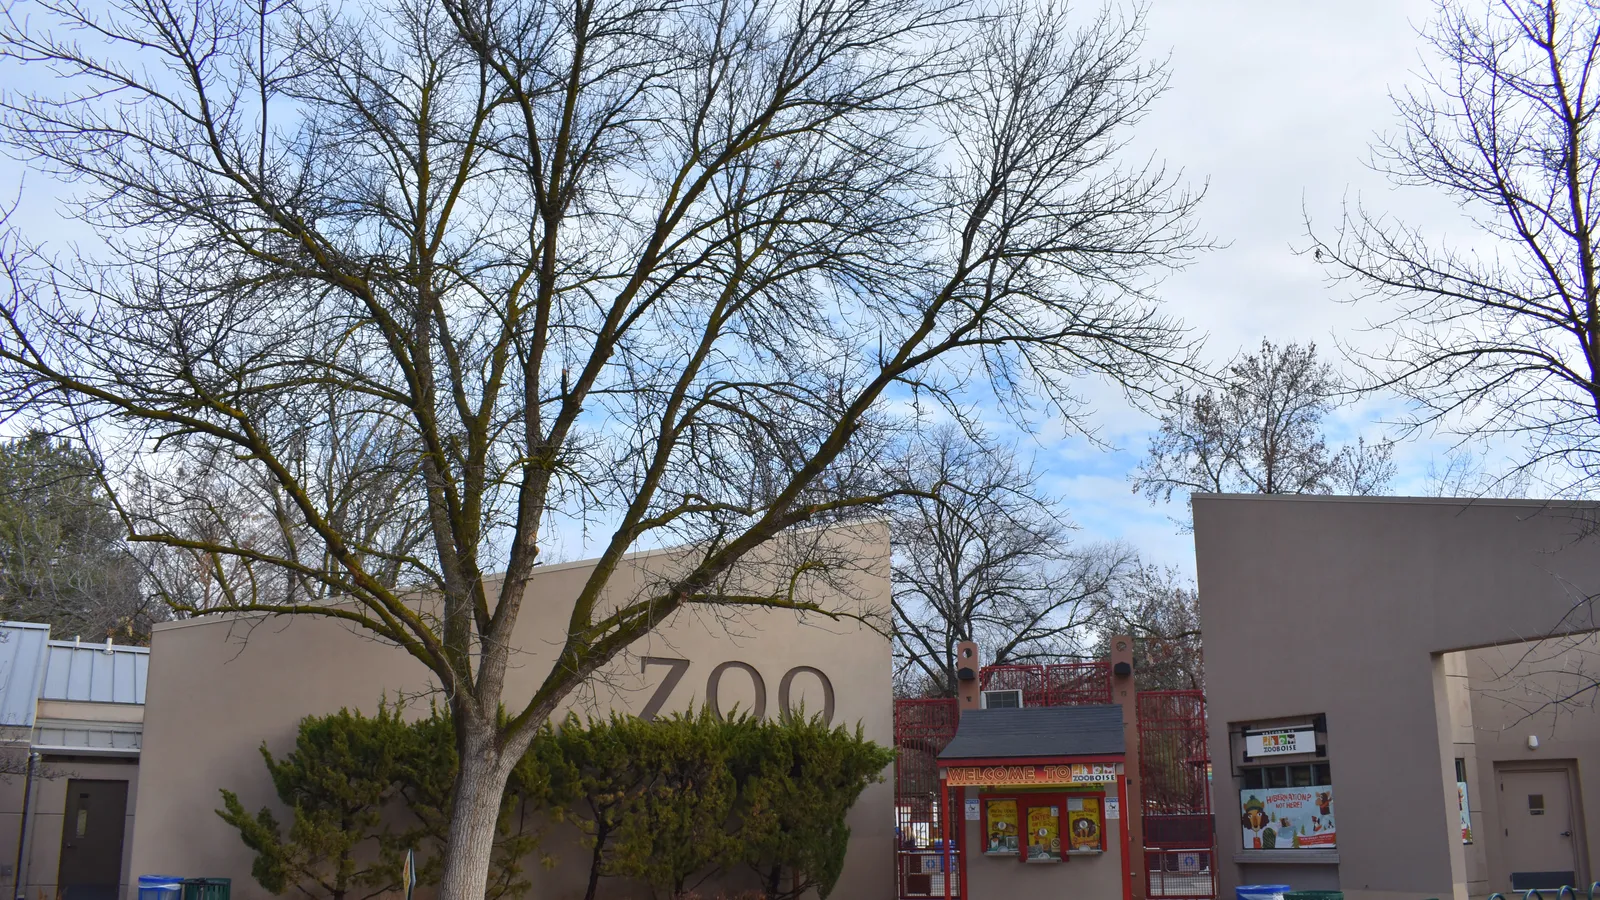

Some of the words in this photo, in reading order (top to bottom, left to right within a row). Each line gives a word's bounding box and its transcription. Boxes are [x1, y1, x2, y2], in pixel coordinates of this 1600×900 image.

[638, 656, 836, 728] ZOO
[949, 767, 1035, 781] WELCOME
[1044, 765, 1071, 780] TO
[1266, 793, 1312, 804] HIBERNATION?
[1286, 801, 1303, 809] HERE!
